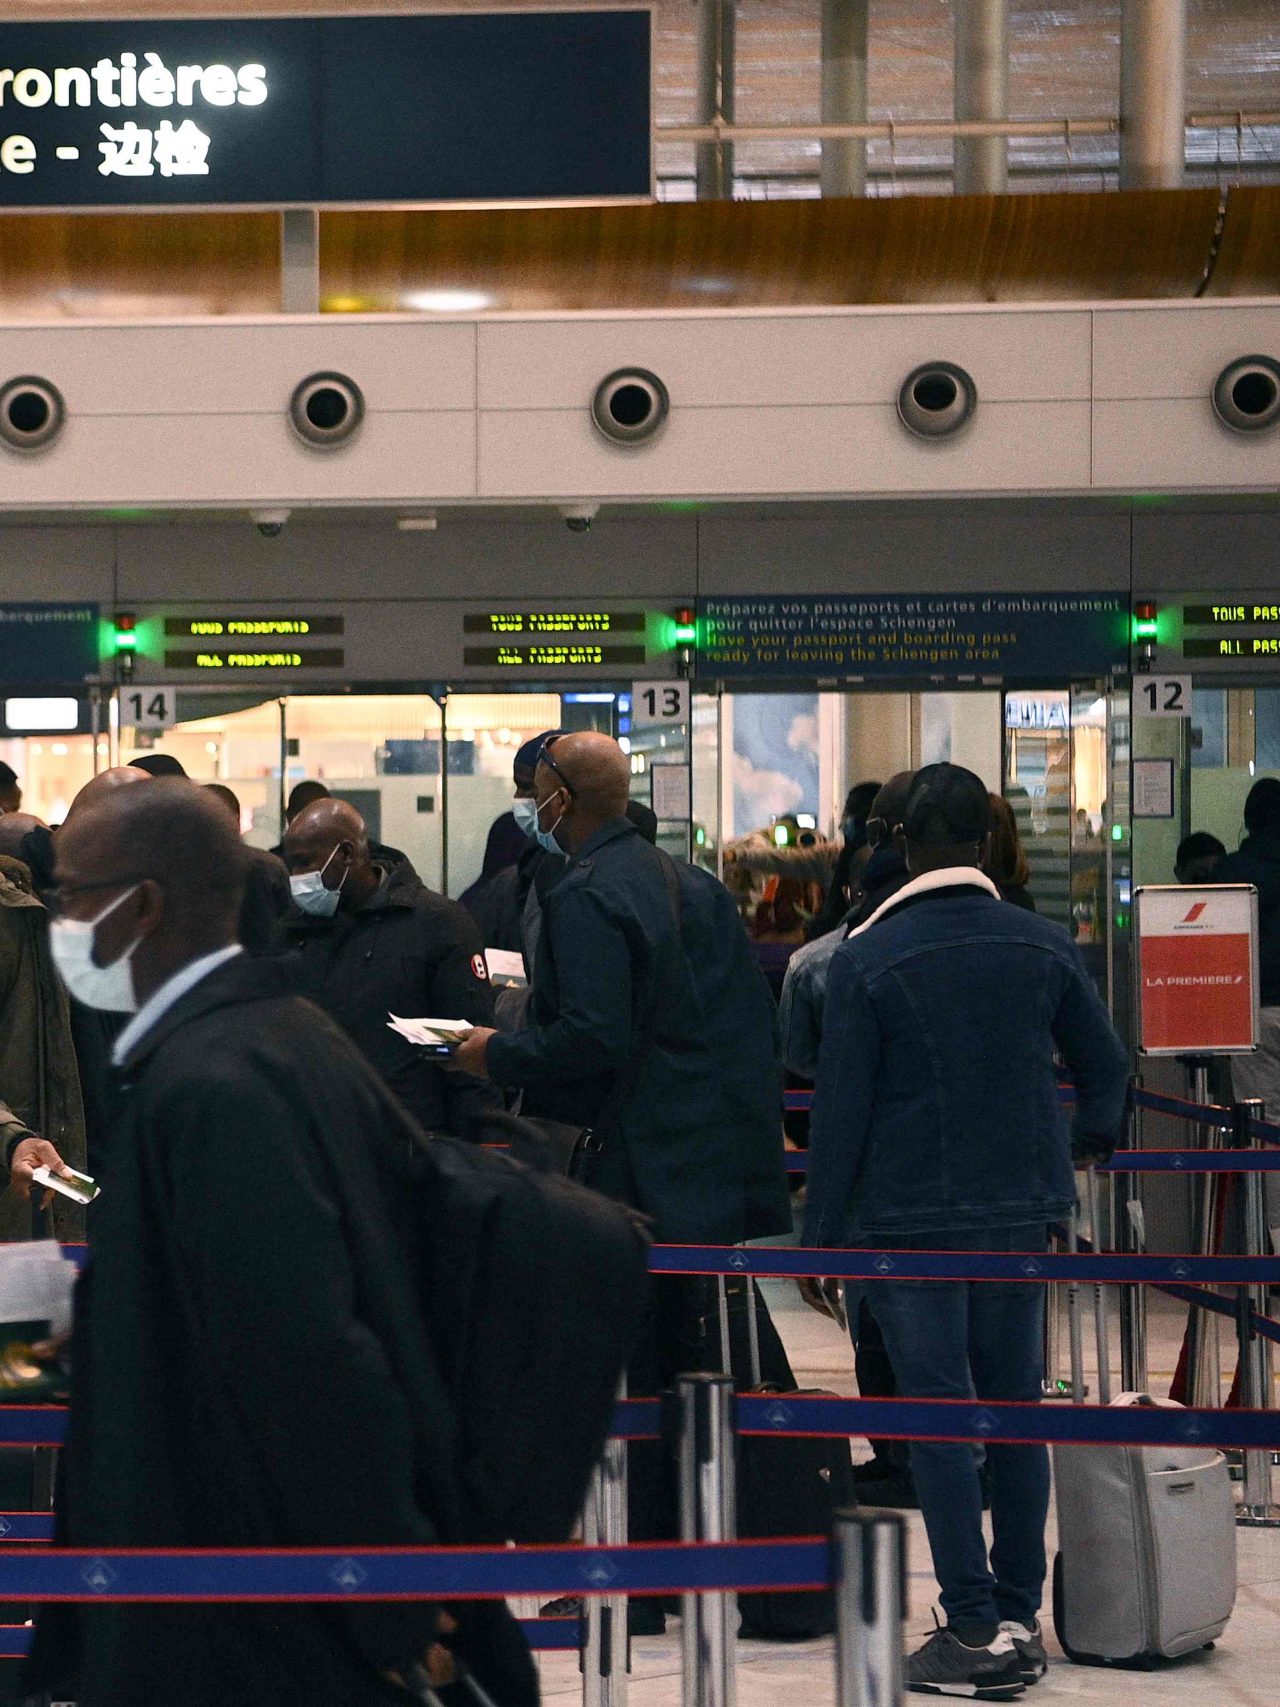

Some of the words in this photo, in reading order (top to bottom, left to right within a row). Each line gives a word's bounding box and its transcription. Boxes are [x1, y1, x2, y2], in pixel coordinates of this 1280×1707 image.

[55, 146, 80, 160] -
[782, 603, 808, 614] vos
[814, 602, 901, 616] passeports
[906, 601, 921, 613] et
[928, 601, 976, 613] cartes
[982, 599, 1120, 614] d'embarquement
[1212, 606, 1245, 621] TOUS
[1253, 606, 1280, 621] PAS
[706, 618, 742, 632] pour
[749, 618, 805, 632] quitter
[810, 616, 874, 632] l'espace
[880, 616, 956, 632] Schengen
[751, 634, 787, 648] your
[793, 632, 862, 648] passport
[868, 632, 897, 645] and
[903, 631, 976, 647] boarding
[982, 632, 1018, 646] pass
[1220, 640, 1245, 655] ALL
[1253, 640, 1280, 655] PAS
[757, 648, 780, 661] for
[786, 648, 845, 663] leaving
[851, 647, 877, 661] the
[882, 646, 959, 664] Schengen
[965, 648, 1001, 661] area
[642, 688, 681, 717] 13
[1143, 682, 1184, 711] 12
[129, 693, 168, 721] 14
[1146, 977, 1164, 987] LA
